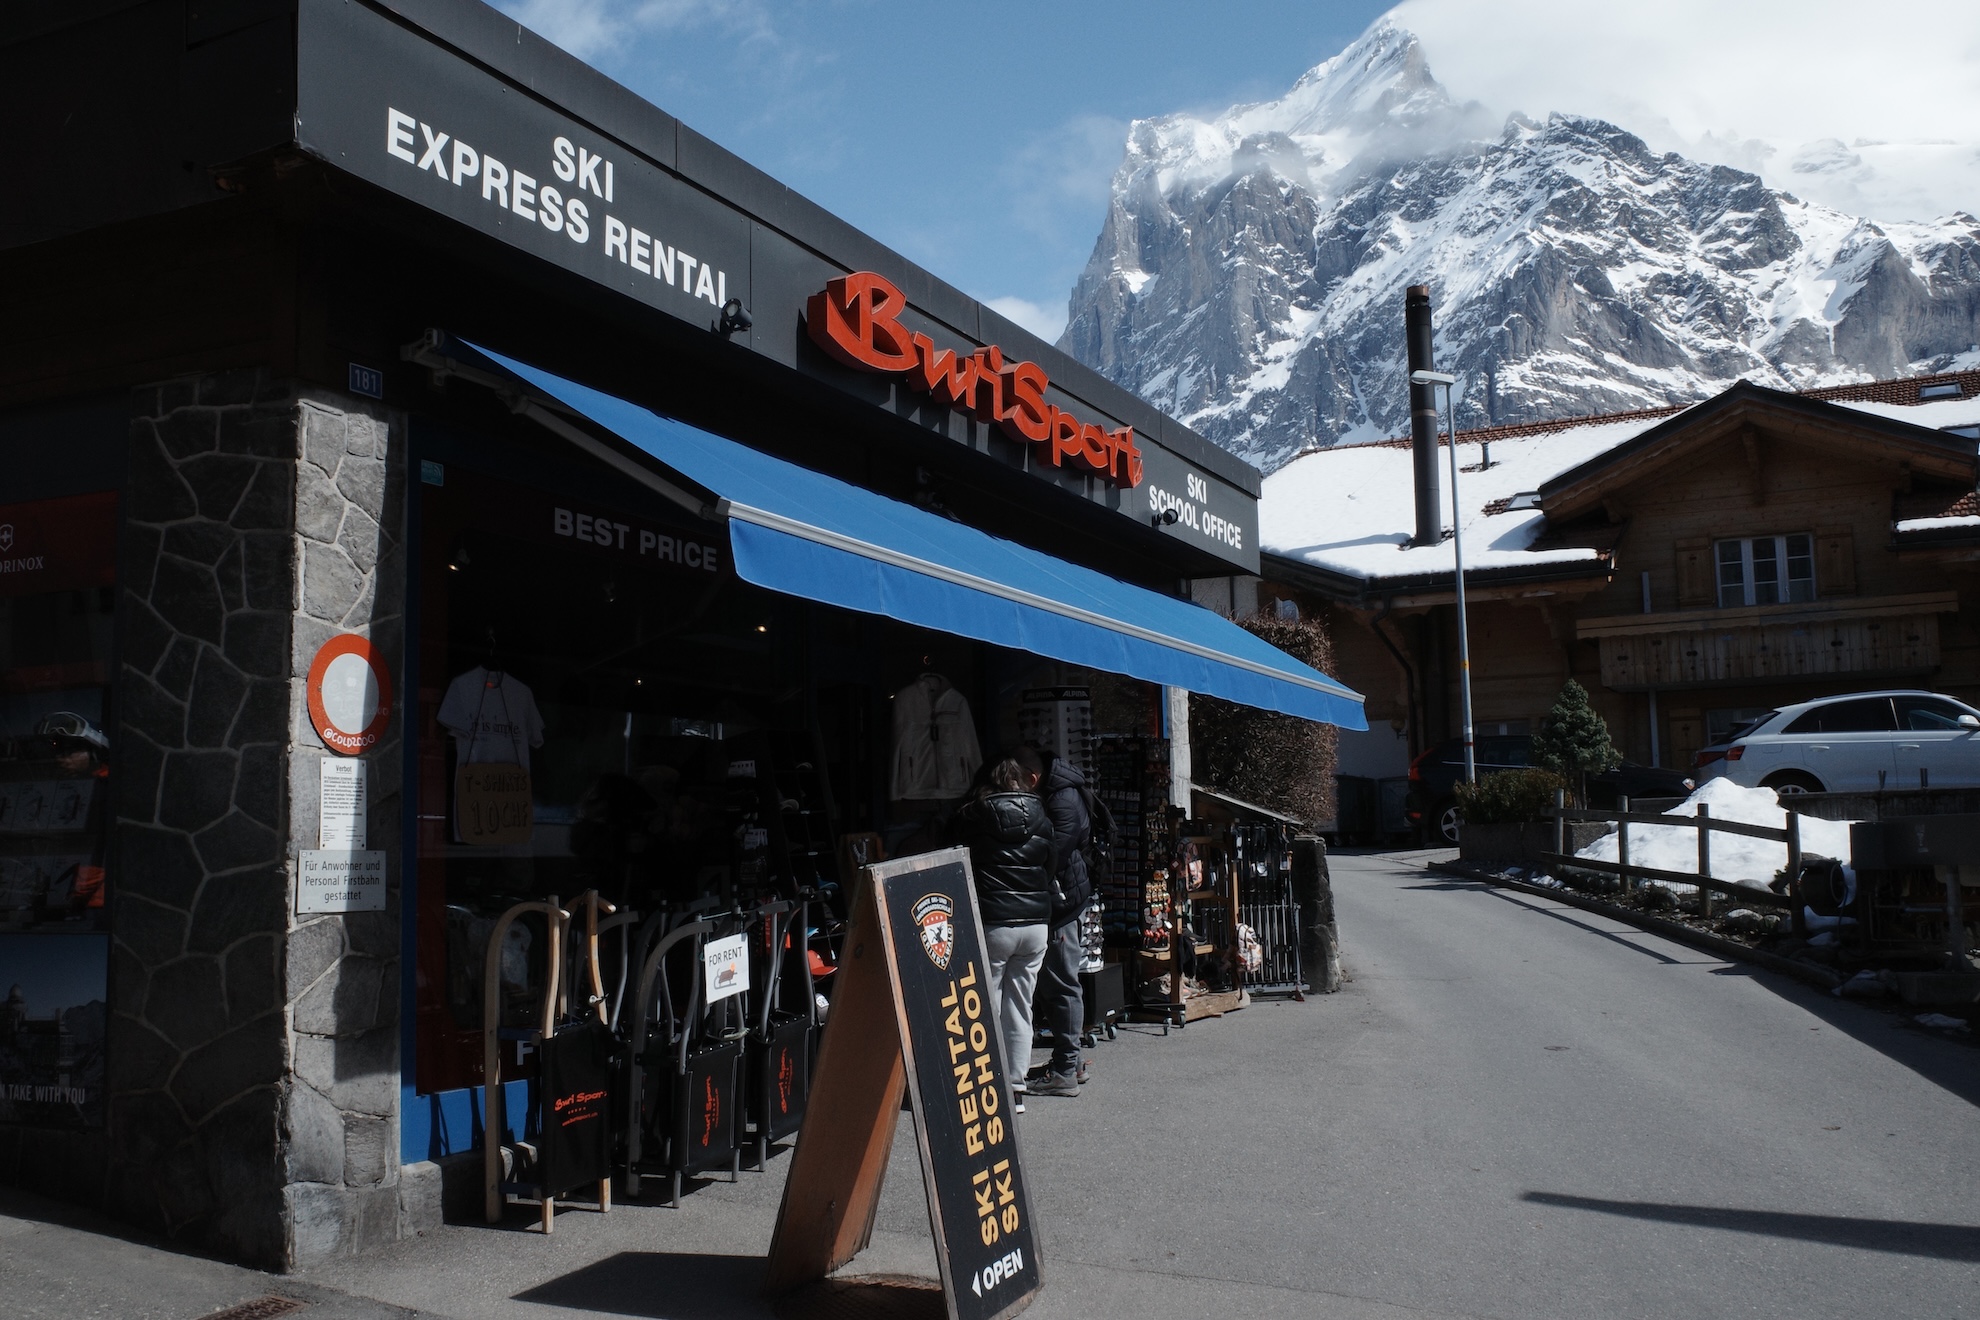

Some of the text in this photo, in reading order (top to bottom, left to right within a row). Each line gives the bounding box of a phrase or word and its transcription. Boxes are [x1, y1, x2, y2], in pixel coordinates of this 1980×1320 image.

[387, 106, 590, 244] EXPRESS
[552, 136, 613, 203] SKI
[354, 369, 376, 393] 181
[1187, 473, 1207, 504] SKI
[1149, 484, 1242, 550] SCHOOL OFFICE
[554, 507, 717, 572] BEST PRICE
[1062, 690, 1088, 698] ALPINA
[335, 765, 352, 773] Verbot
[305, 860, 380, 871] Für Anwohner und
[305, 875, 380, 886] Personal Firstbahn
[324, 891, 362, 904] gestattet
[709, 946, 743, 967] FOR RENT
[8, 1084, 32, 1102] TAKE
[35, 1085, 61, 1104] WITH
[65, 1087, 86, 1105] YOU
[960, 961, 1019, 1234] SKI SCHOOL
[941, 980, 999, 1247] SKI RENTAL
[982, 1248, 1024, 1291] OPEN
